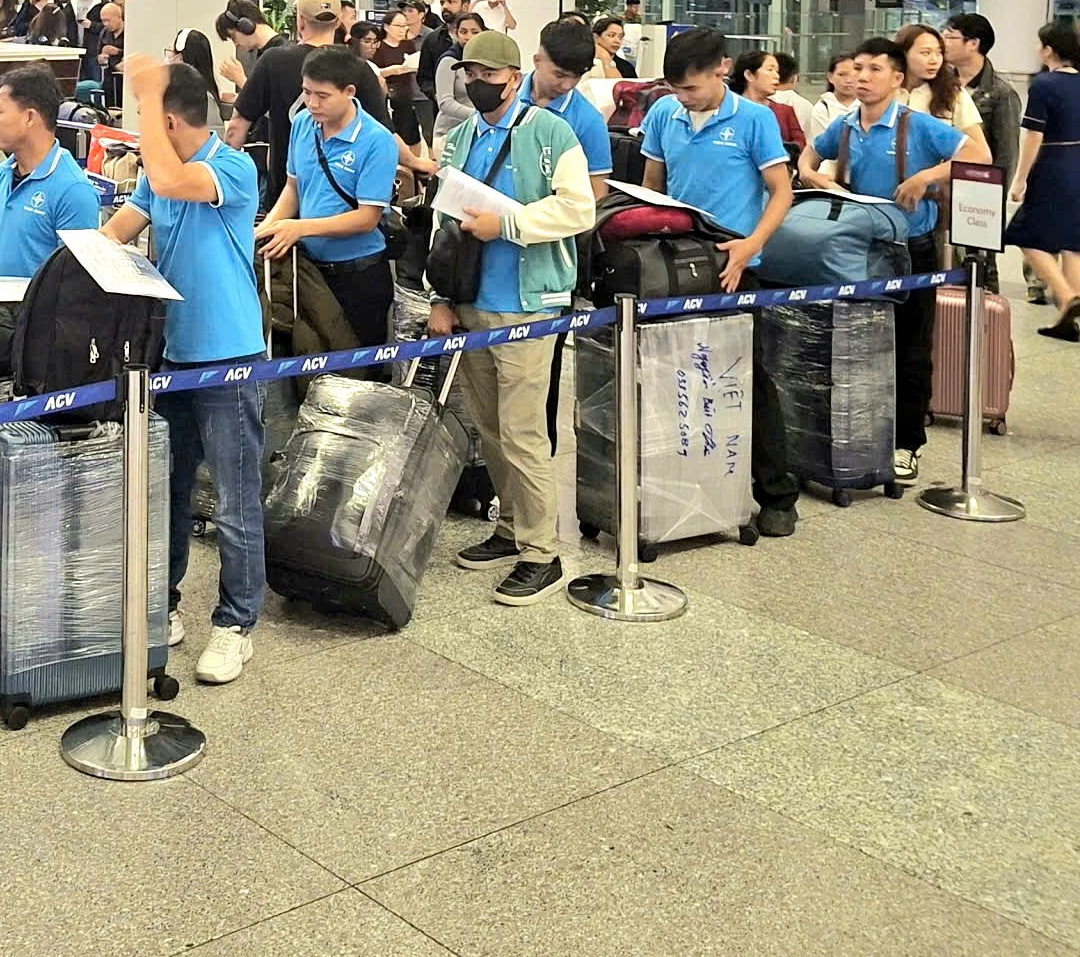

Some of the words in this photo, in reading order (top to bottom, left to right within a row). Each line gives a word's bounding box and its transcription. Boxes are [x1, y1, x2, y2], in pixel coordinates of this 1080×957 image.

[959, 203, 996, 219] Economy
[967, 216, 988, 228] Class
[684, 298, 703, 309] ACV
[737, 294, 756, 305] ACV
[224, 366, 252, 382] ACV
[302, 356, 328, 372] ACV
[374, 346, 399, 361] ACV
[443, 336, 466, 350] ACV
[508, 326, 530, 340] ACV
[570, 314, 590, 328] ACV
[44, 392, 76, 411] ACV
